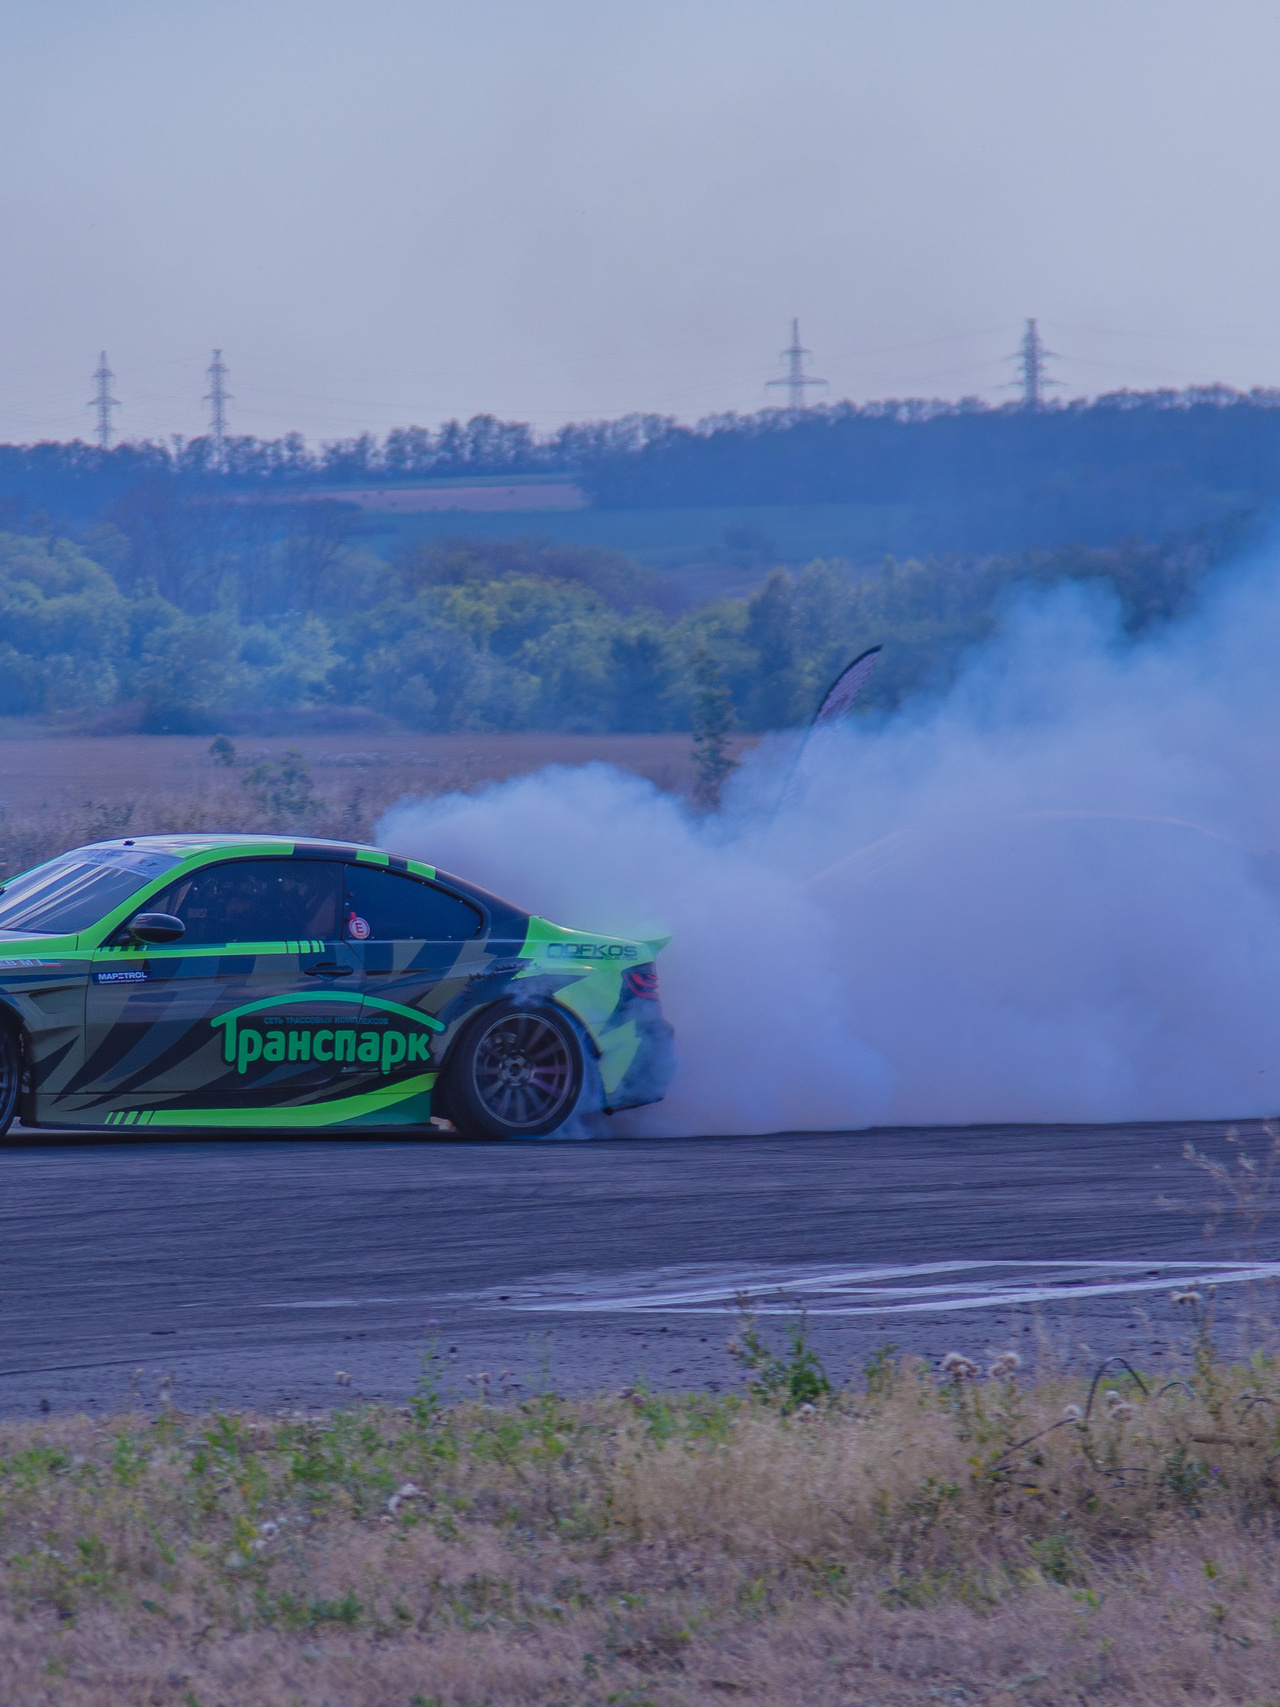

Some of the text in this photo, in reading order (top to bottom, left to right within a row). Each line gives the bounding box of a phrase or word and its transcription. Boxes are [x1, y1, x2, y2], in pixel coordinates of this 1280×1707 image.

[355, 922, 364, 934] E
[263, 1015, 389, 1026] СЕТЬ ТРАССОВЫХ КОМПЛЕКСОВ
[210, 991, 445, 1074] Транспарк
